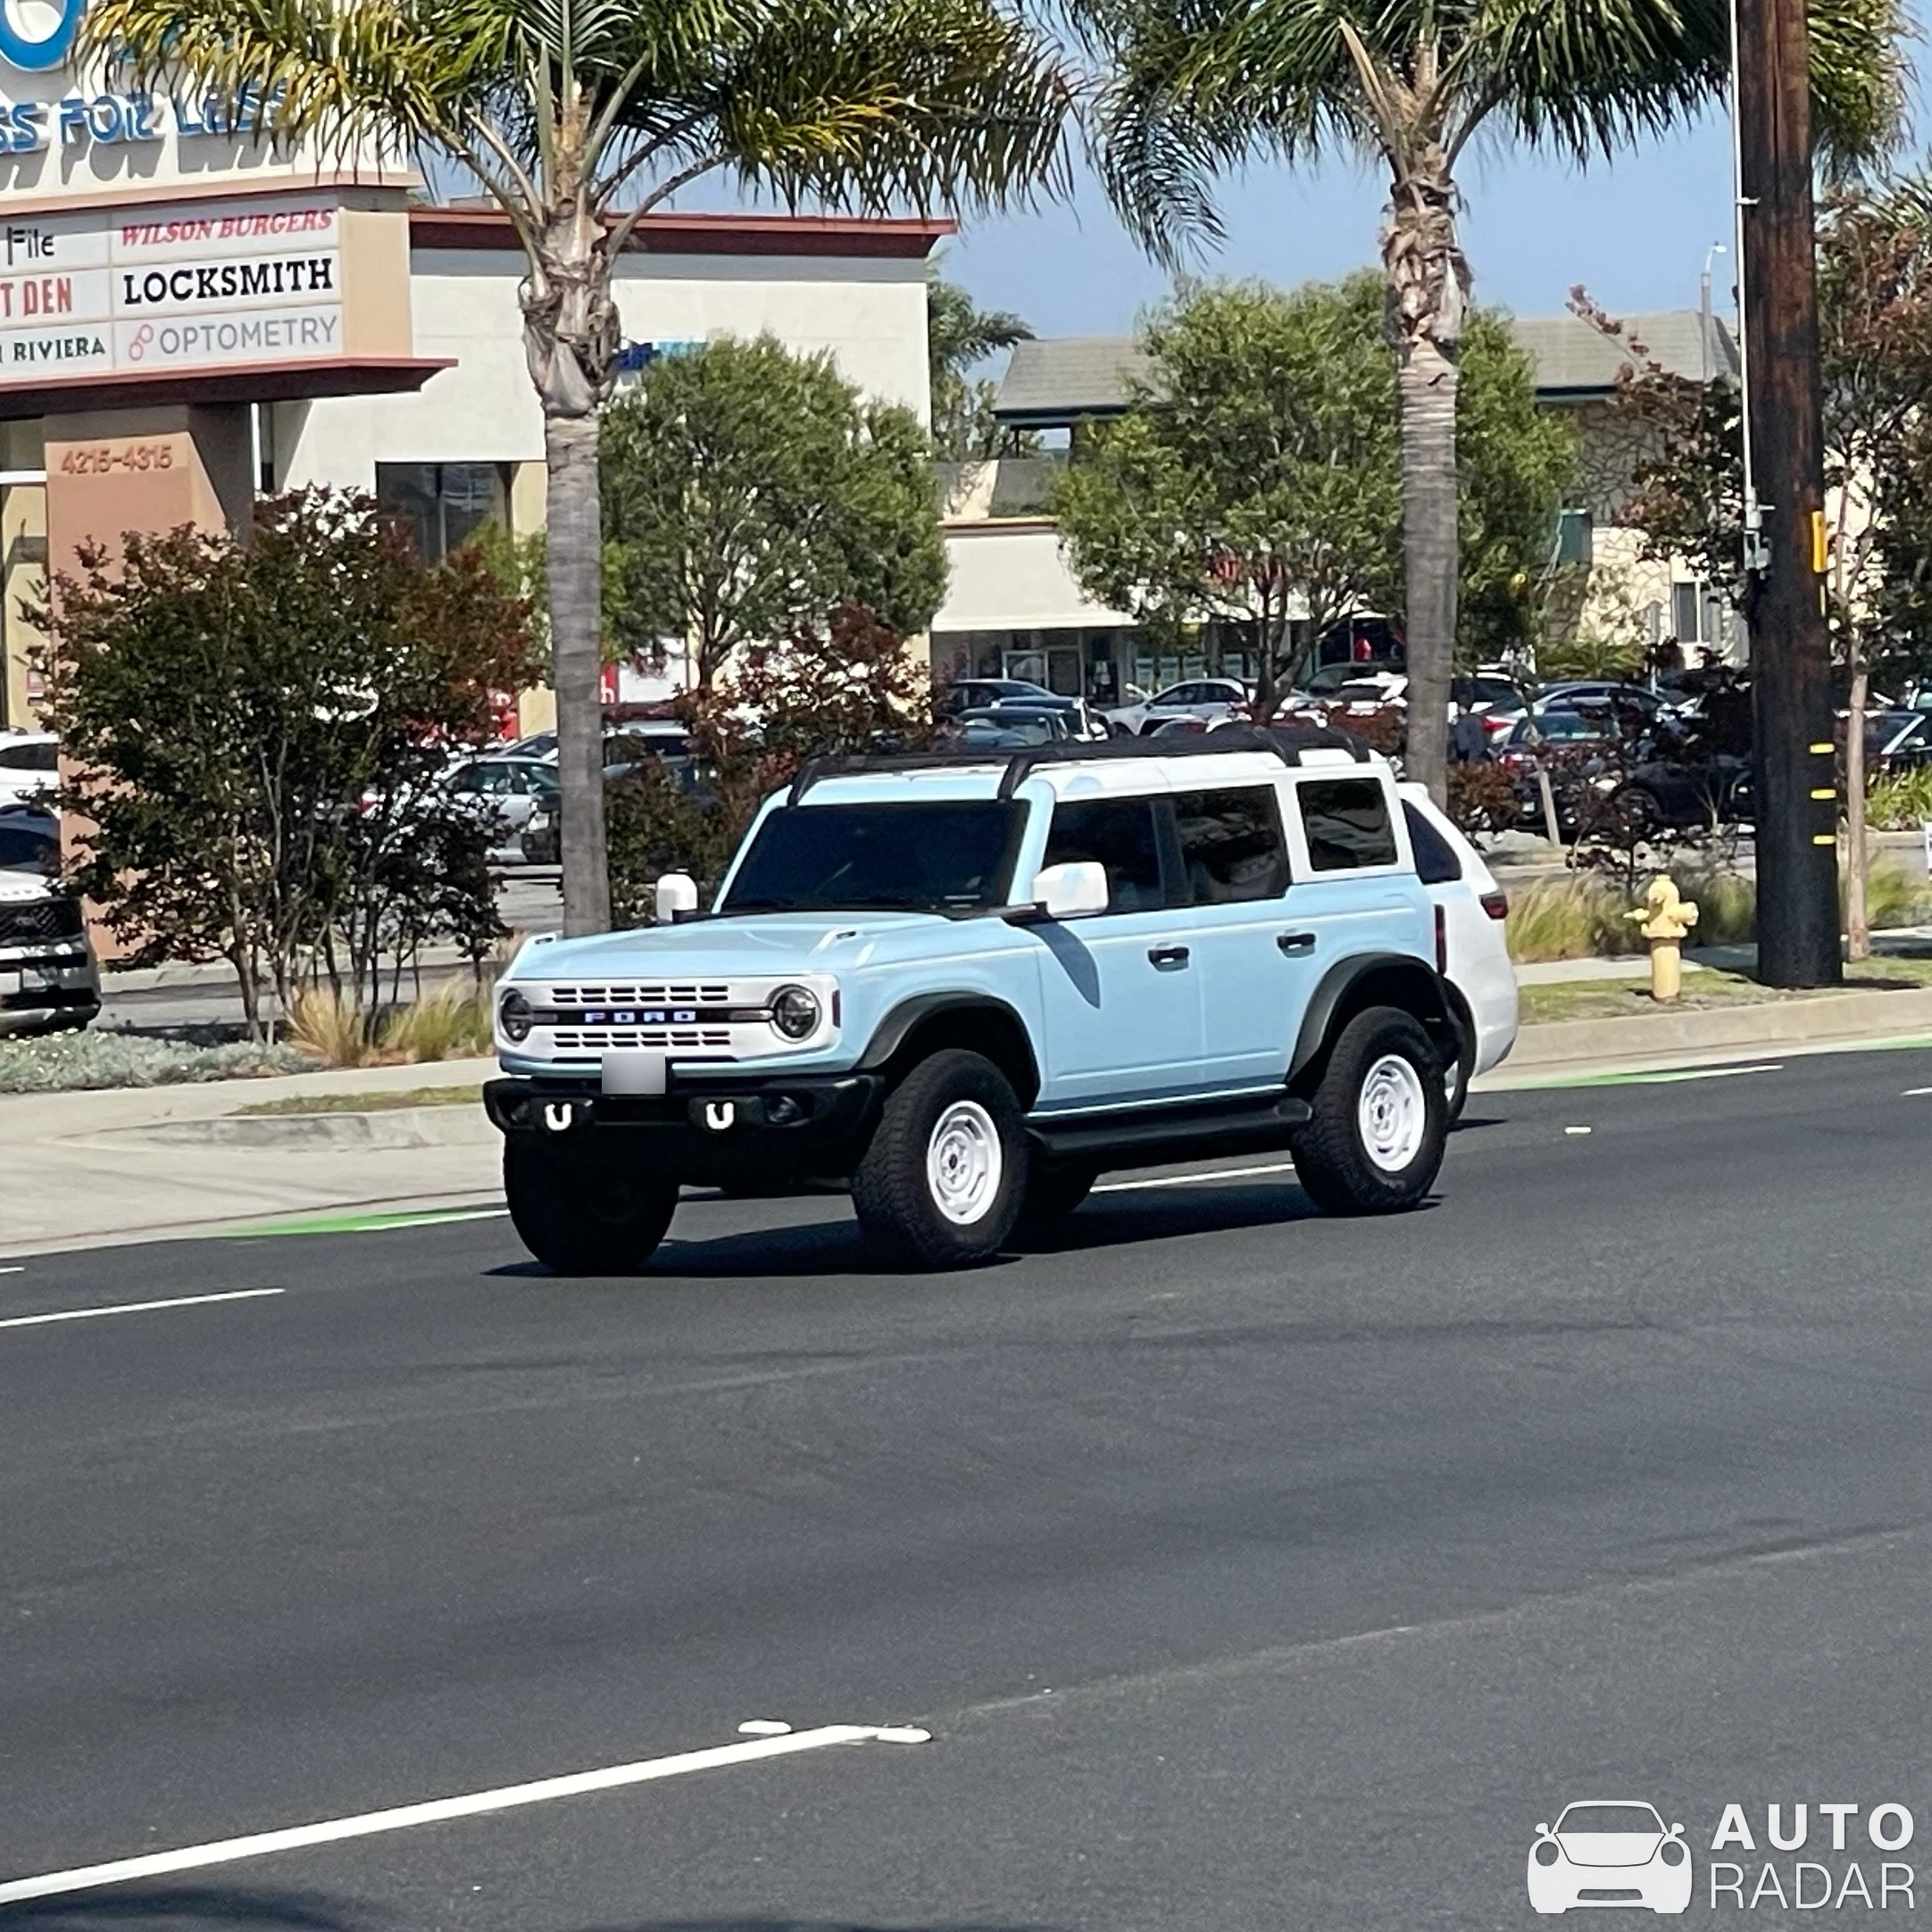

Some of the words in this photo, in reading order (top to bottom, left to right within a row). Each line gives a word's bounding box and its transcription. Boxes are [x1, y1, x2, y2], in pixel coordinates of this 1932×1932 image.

[7, 226, 54, 266] File
[122, 220, 215, 246] WILSON
[219, 209, 336, 239] BURGERS
[23, 278, 72, 316] DEN
[123, 258, 333, 305] LOCKSMITH
[13, 337, 105, 361] RIVIERA
[160, 315, 337, 354] OPTOMETRY
[61, 446, 173, 474] 4215-4315
[585, 1011, 696, 1023] FORD
